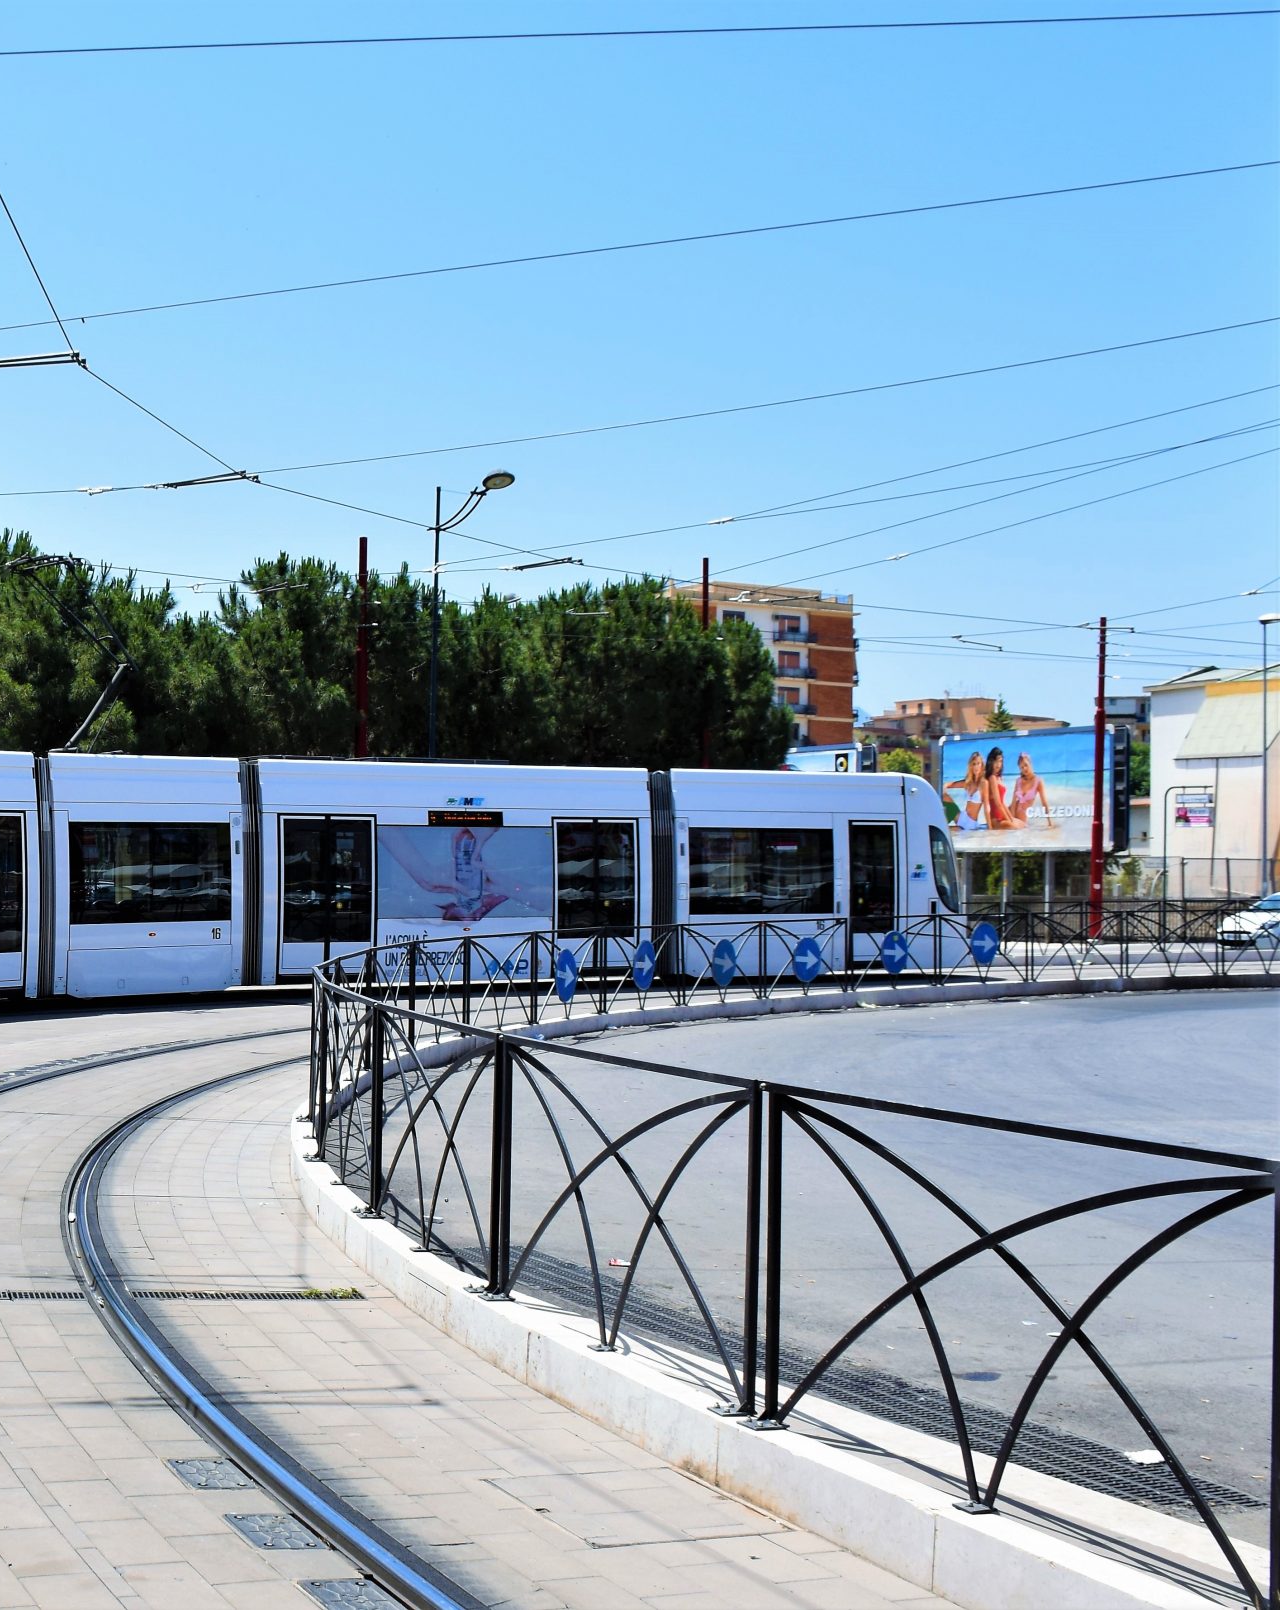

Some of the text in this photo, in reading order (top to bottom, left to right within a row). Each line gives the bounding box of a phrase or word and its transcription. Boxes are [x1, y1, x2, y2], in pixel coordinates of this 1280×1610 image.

[1025, 804, 1095, 818] CALZEDONI
[211, 927, 221, 940] 16
[385, 952, 399, 967] UN
